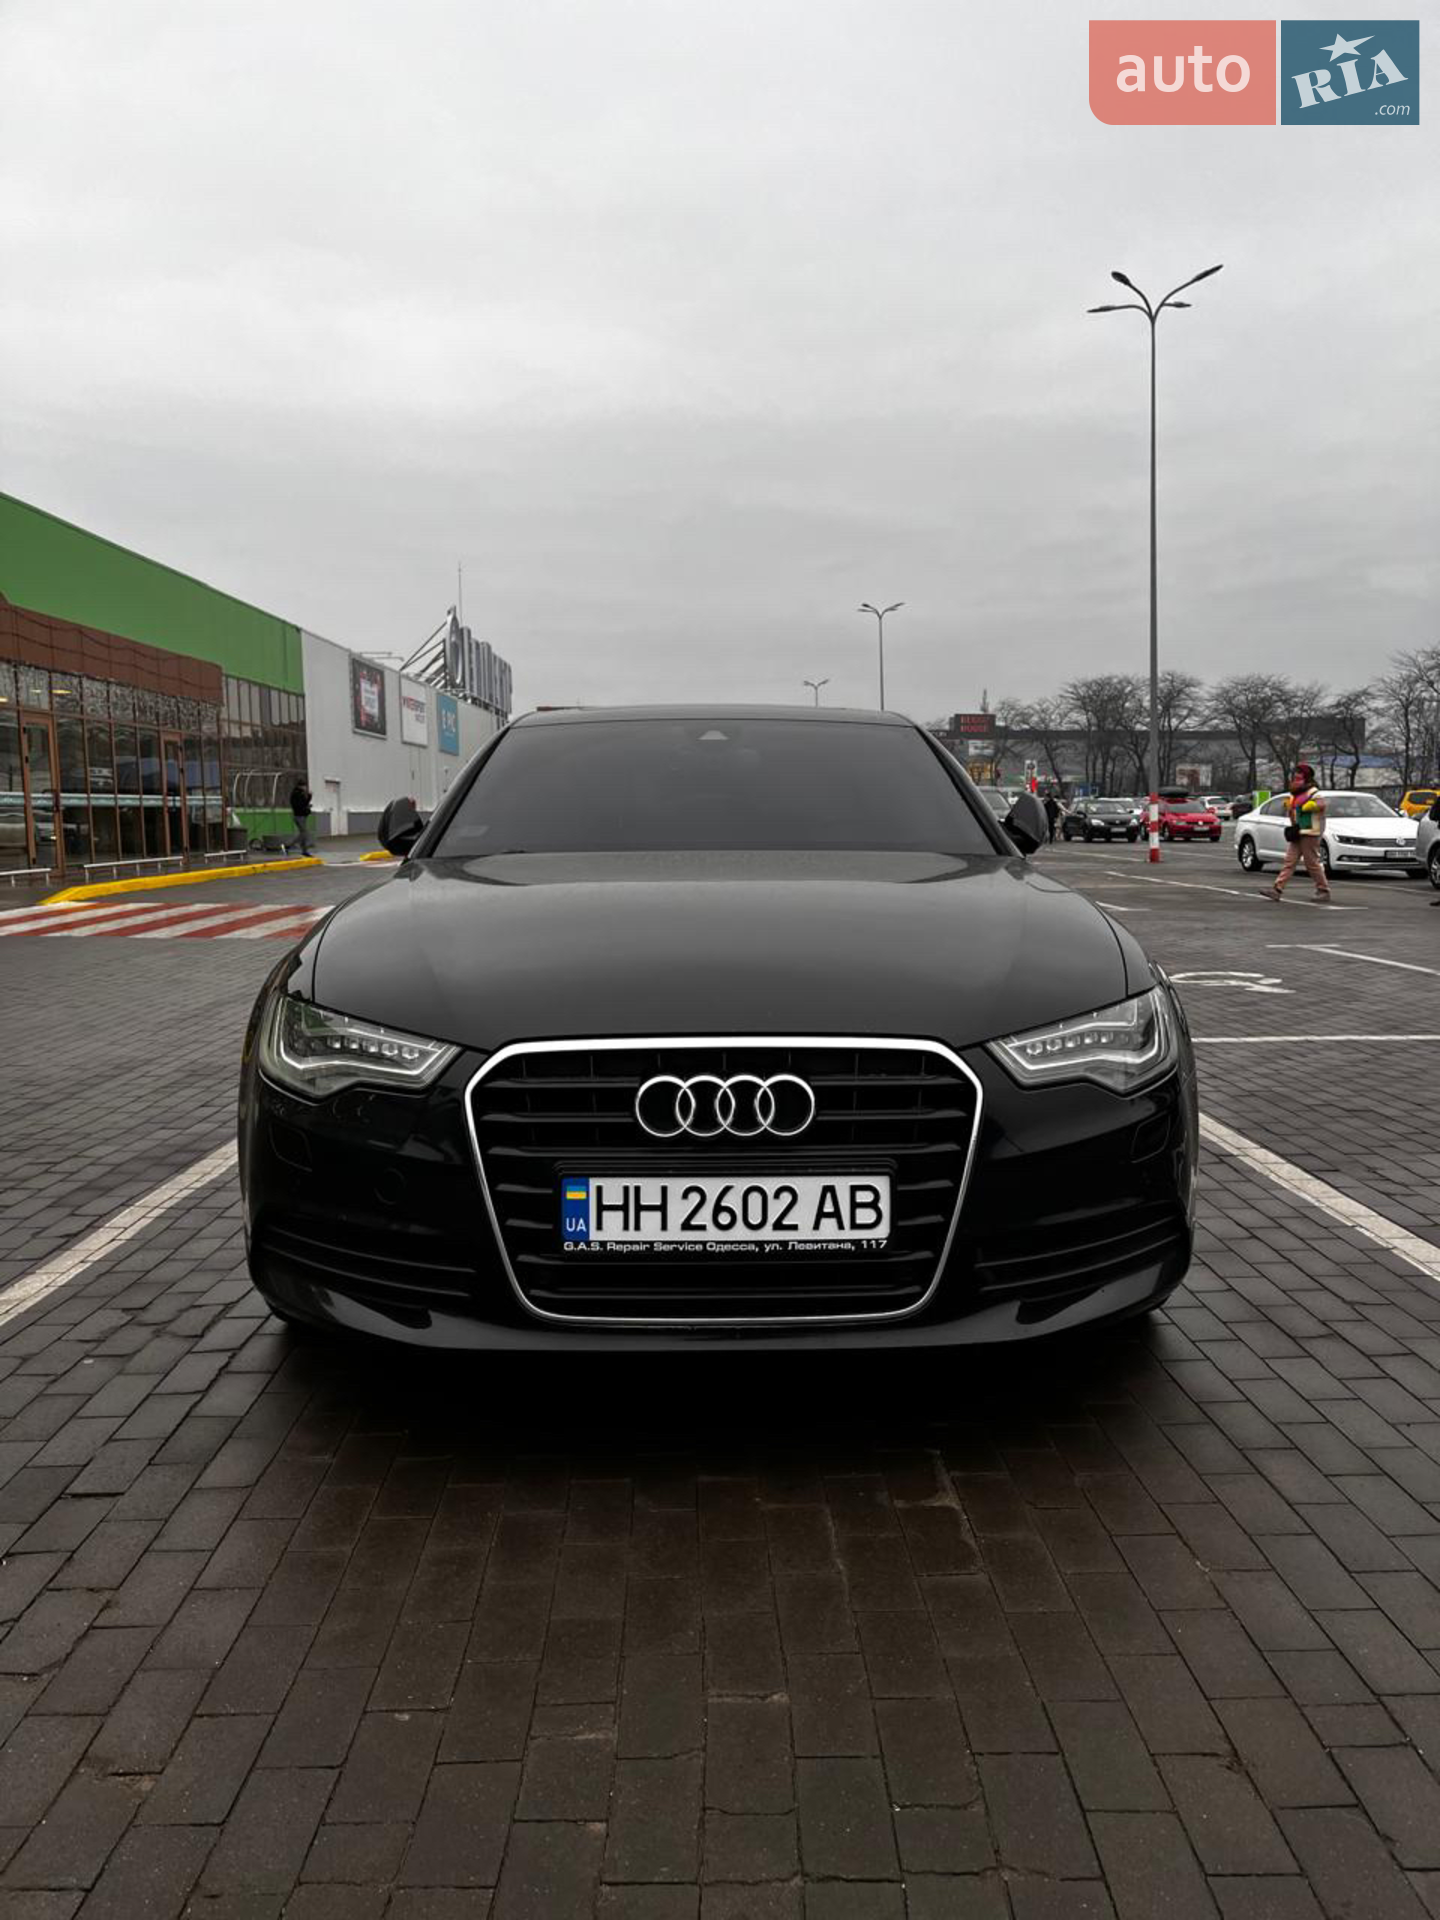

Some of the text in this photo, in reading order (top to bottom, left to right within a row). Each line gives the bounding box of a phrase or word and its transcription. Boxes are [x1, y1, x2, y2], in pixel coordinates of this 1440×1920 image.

[595, 1184, 883, 1232] HH 2602 AB
[566, 1217, 587, 1232] UA
[563, 1241, 603, 1252] G.A.S.
[606, 1241, 650, 1253] Repair
[653, 1241, 703, 1252] Service
[706, 1241, 759, 1253] Одесса,
[764, 1242, 783, 1253] ул.
[861, 1239, 888, 1249] 117
